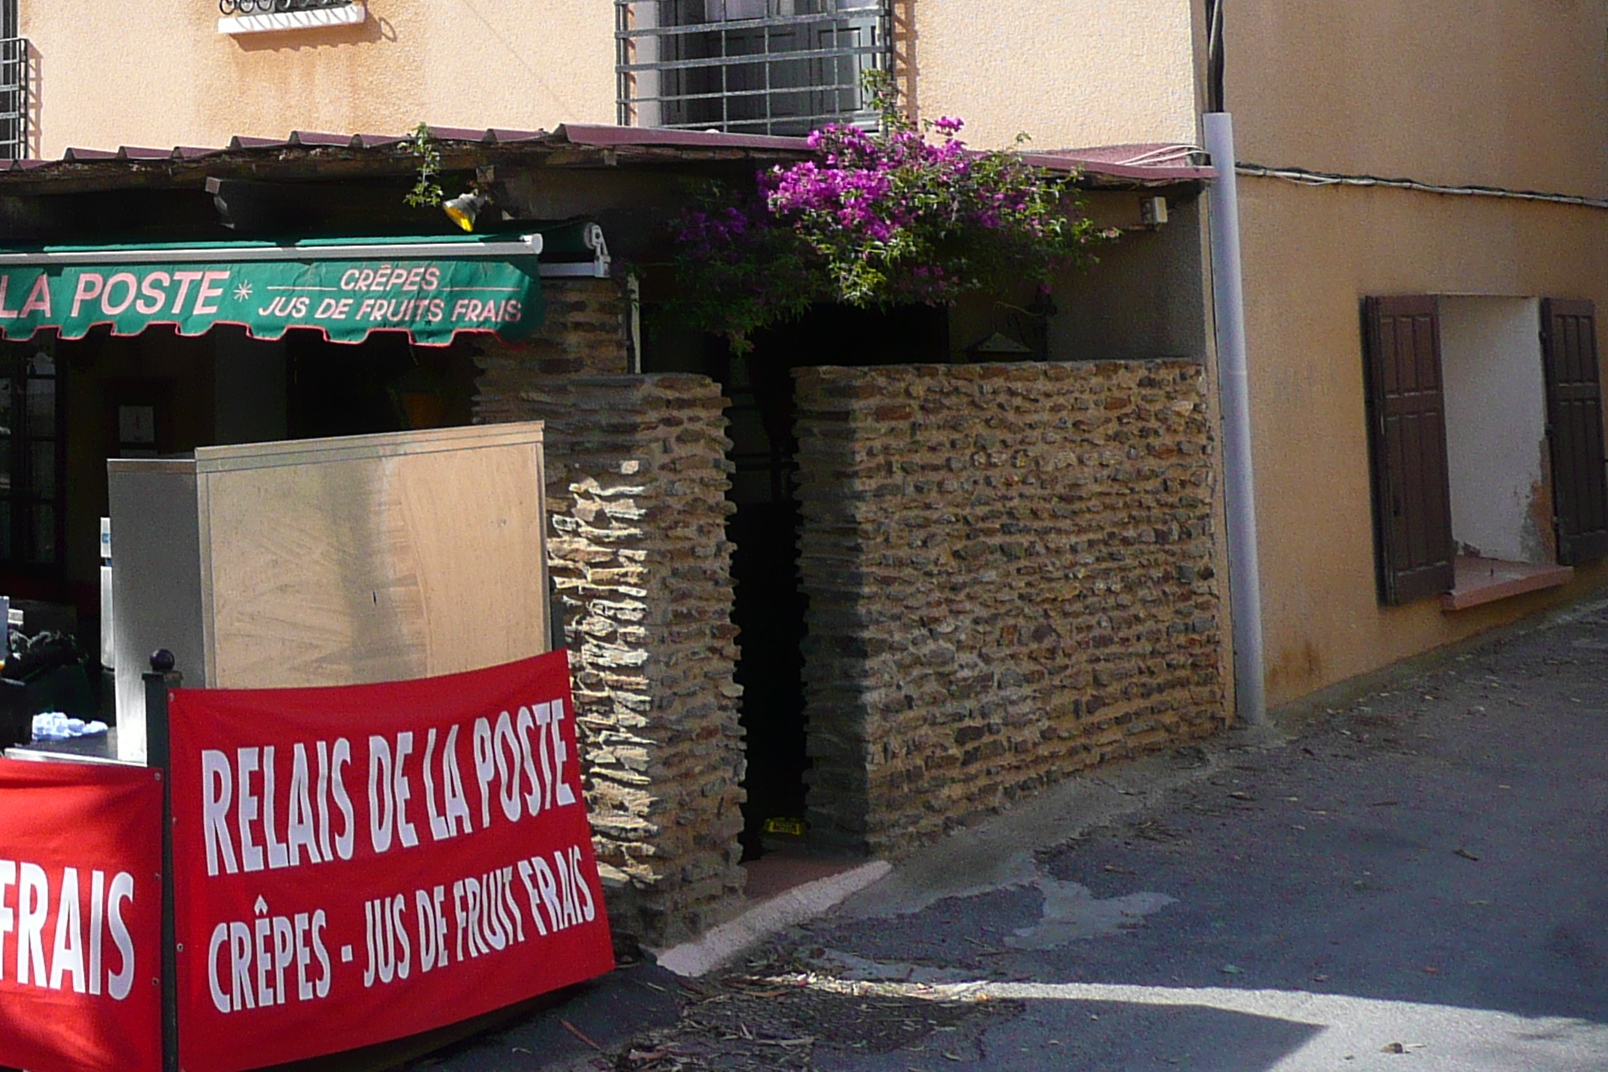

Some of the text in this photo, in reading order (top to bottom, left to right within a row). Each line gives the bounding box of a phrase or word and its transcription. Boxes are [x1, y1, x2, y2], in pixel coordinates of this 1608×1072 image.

[70, 271, 230, 317] POSTE
[340, 264, 441, 291] CRÊPES
[258, 296, 522, 323] JUS DE FRUITS FRAIS
[201, 698, 576, 876] RELAIS DE LA POSTE
[207, 894, 332, 1013] CRÊPES
[363, 893, 411, 988] JUS
[415, 885, 449, 973] DE
[453, 866, 525, 962] FRUIT
[517, 845, 596, 937] FRAIS
